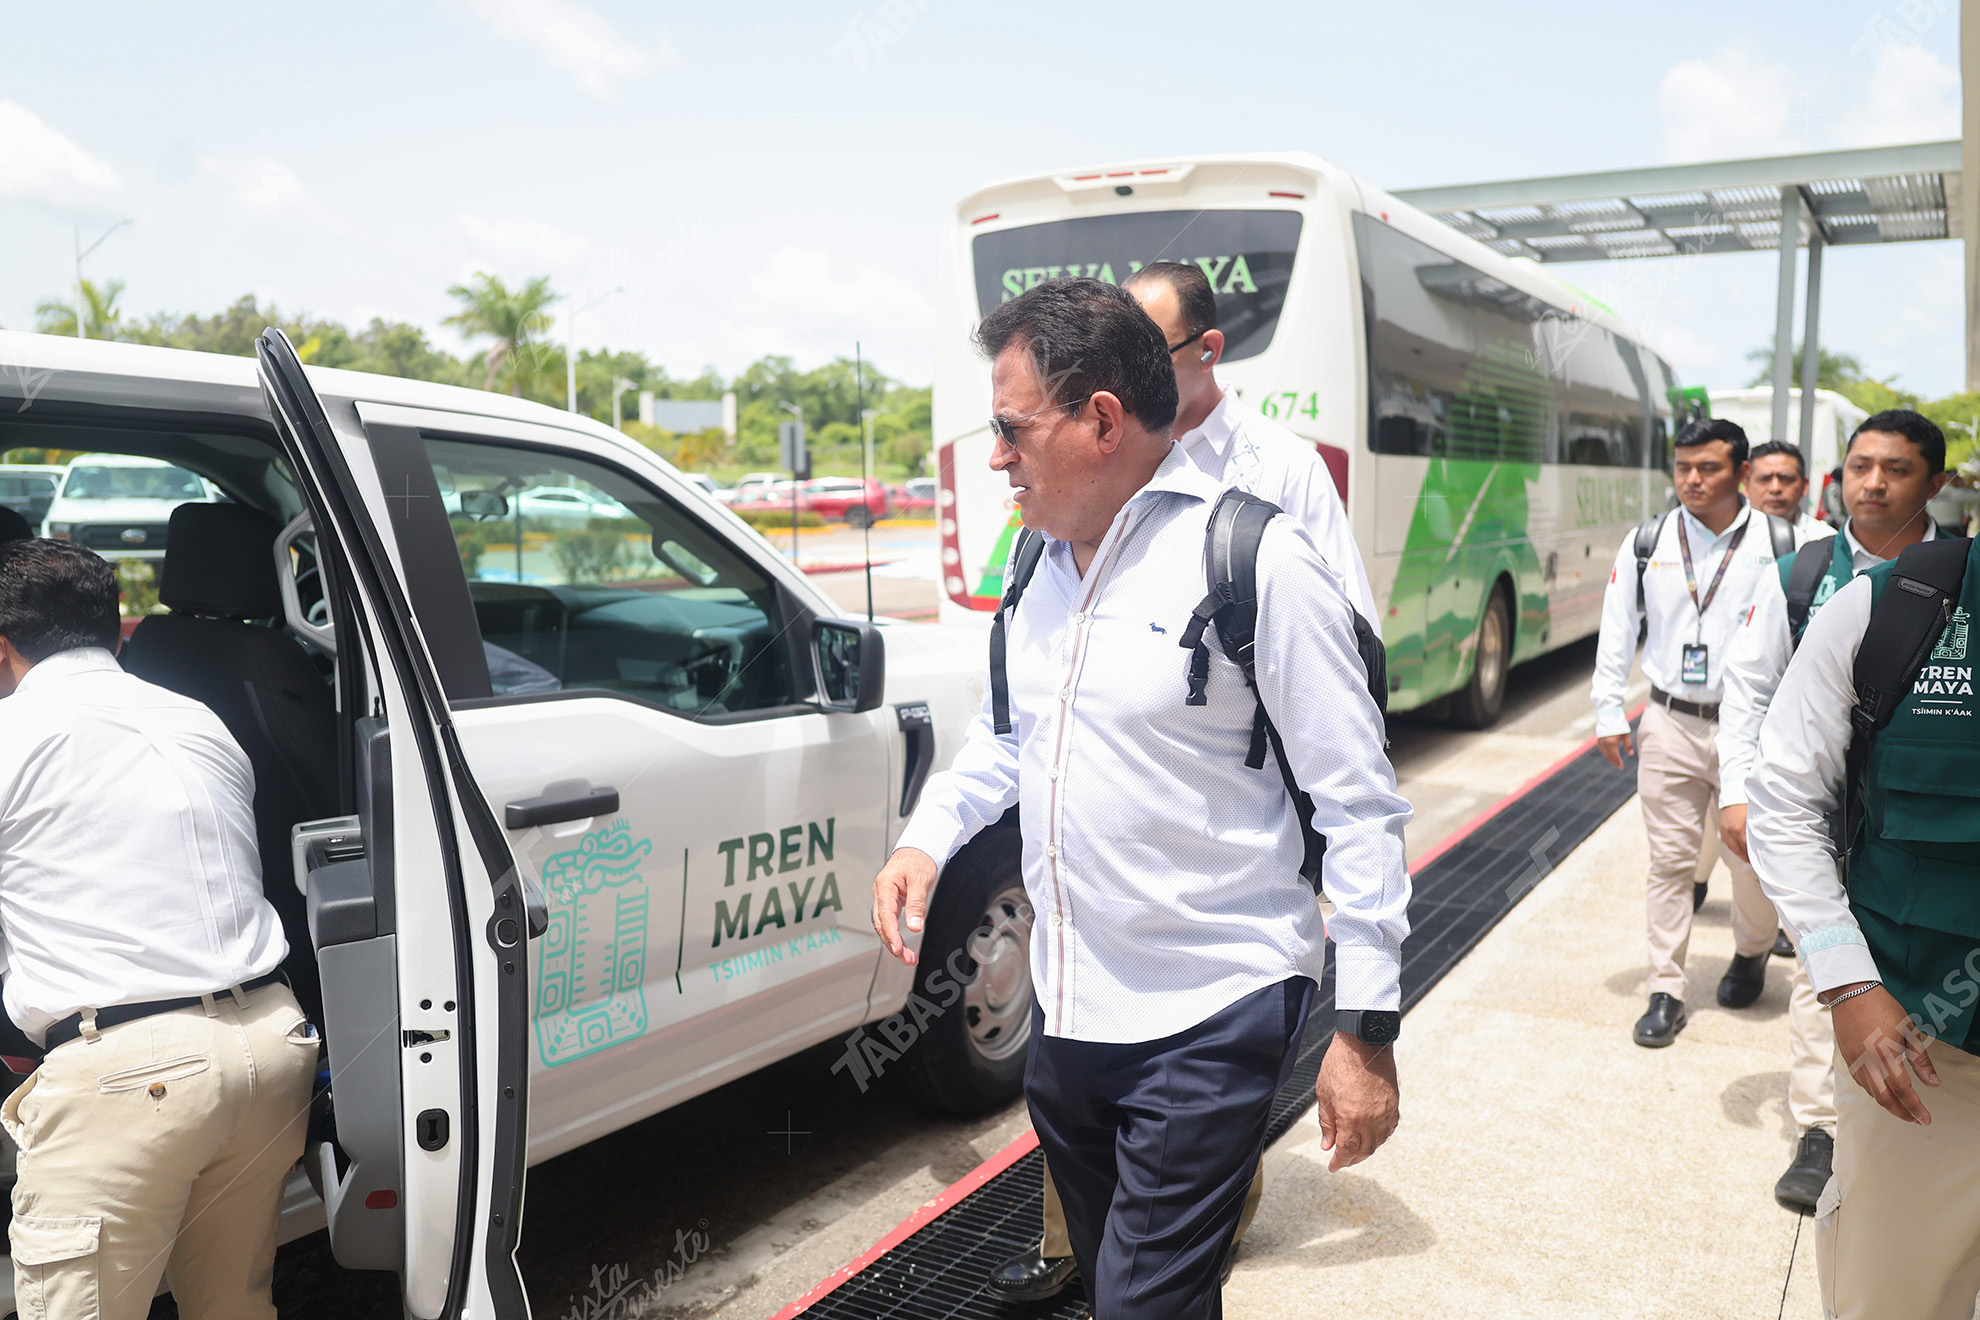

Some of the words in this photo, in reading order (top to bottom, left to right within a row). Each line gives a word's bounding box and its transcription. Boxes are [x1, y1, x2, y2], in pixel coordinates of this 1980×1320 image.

[1261, 391, 1319, 420] 674
[1913, 681, 1974, 695] MAYA
[718, 817, 835, 887] TREN
[712, 871, 843, 948] MAYA
